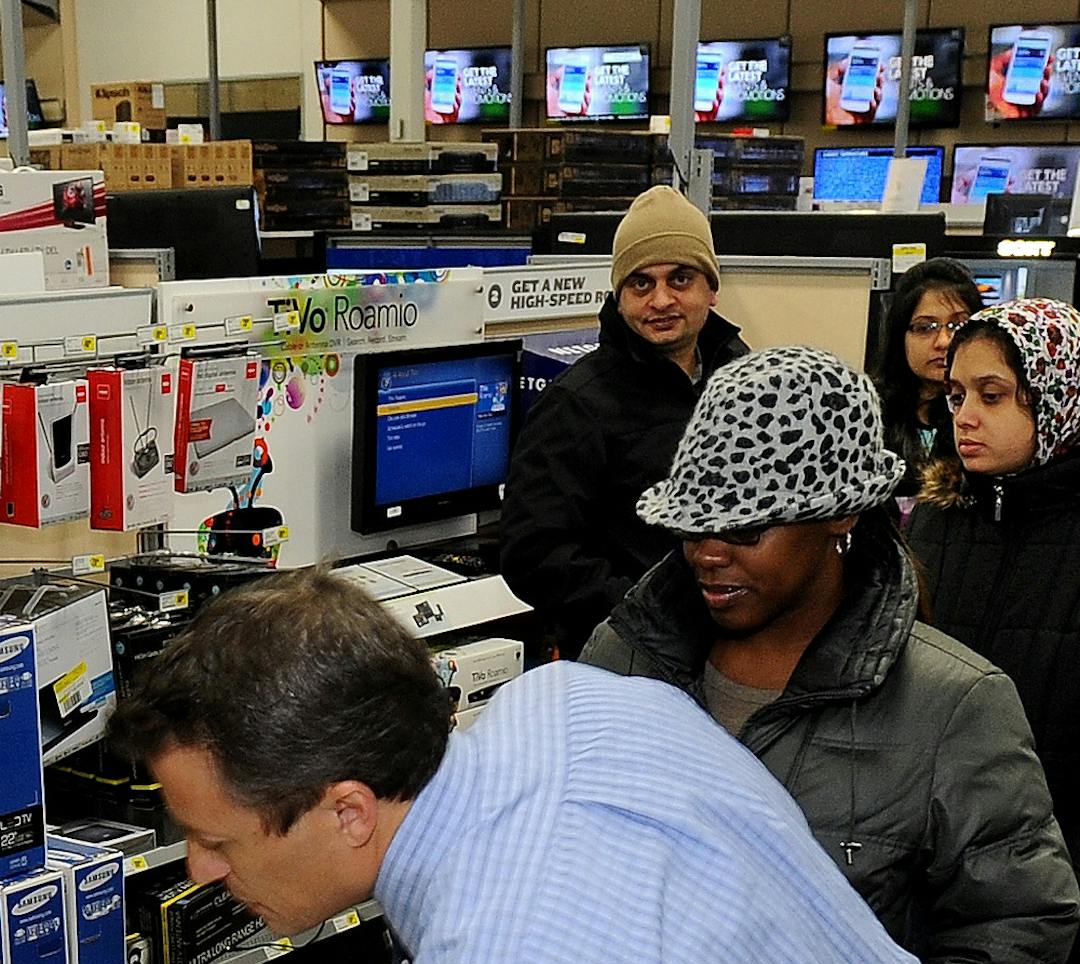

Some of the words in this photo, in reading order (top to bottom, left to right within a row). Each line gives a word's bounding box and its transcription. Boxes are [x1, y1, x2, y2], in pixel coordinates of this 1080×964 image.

[912, 55, 934, 68] THE
[1056, 48, 1080, 60] GET
[1043, 168, 1067, 181] THE
[511, 279, 540, 294] GET
[542, 278, 551, 292] A
[553, 276, 586, 291] NEW
[510, 291, 592, 310] HIGH-SPEED
[333, 292, 418, 333] Roamio
[18, 891, 53, 908] SAMSUNG
[210, 938, 231, 957] LONG
[230, 922, 256, 944] RANGE
